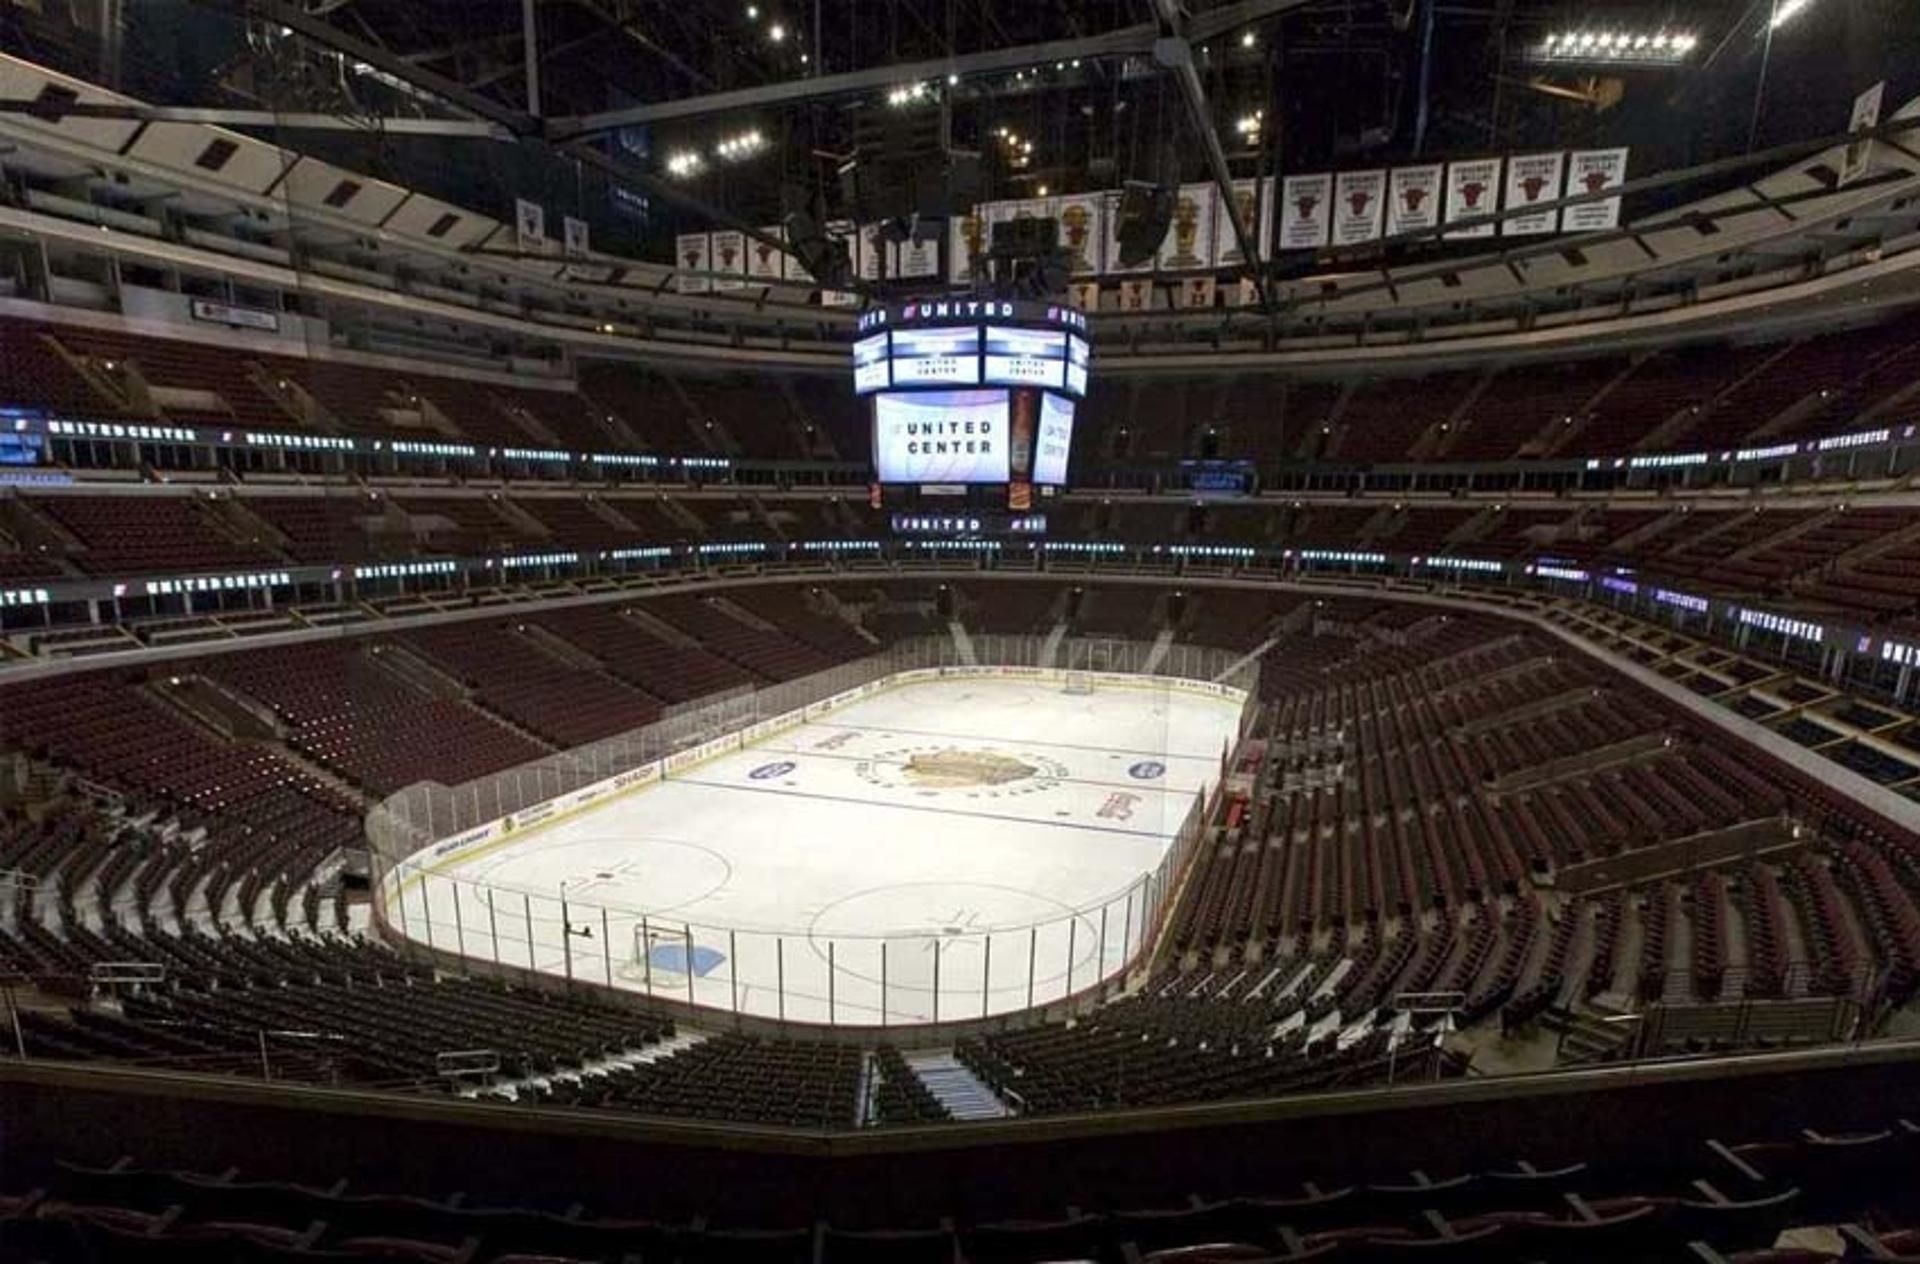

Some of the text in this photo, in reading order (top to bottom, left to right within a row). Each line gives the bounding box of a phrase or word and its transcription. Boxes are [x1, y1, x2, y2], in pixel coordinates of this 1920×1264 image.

[920, 302, 1013, 317] UNITED
[907, 421, 992, 435] UNITED
[907, 440, 992, 454] CENTER
